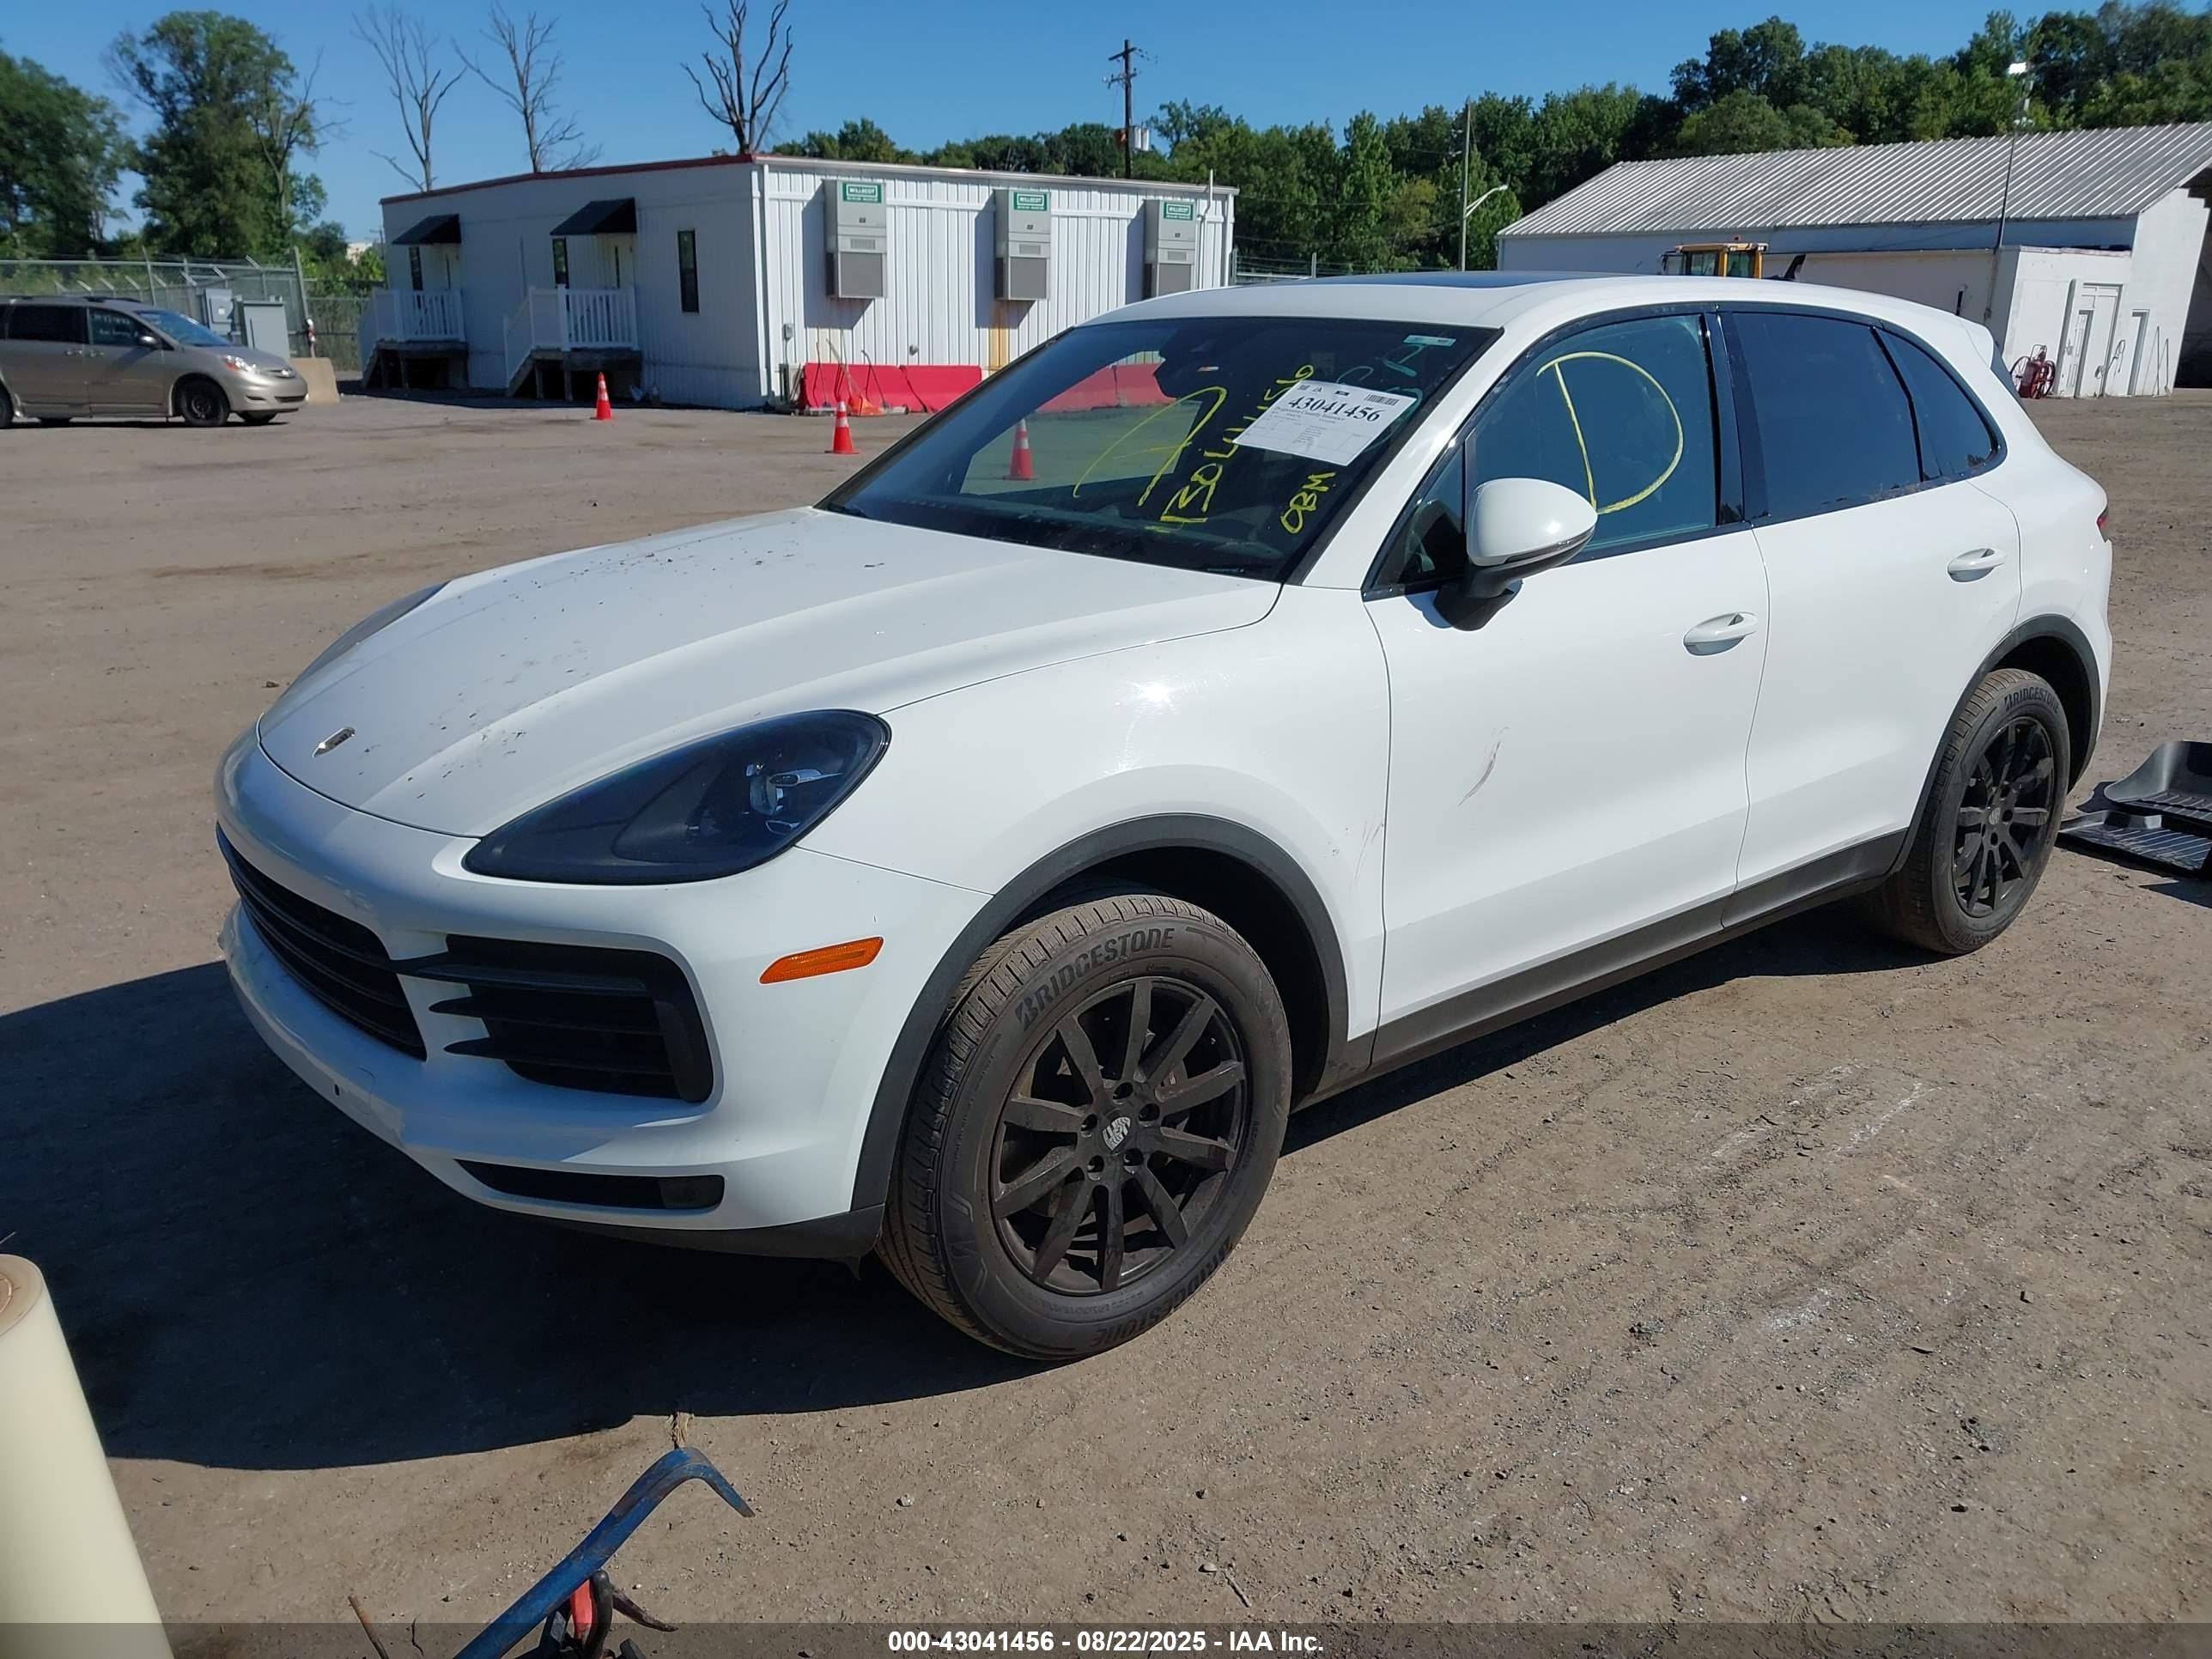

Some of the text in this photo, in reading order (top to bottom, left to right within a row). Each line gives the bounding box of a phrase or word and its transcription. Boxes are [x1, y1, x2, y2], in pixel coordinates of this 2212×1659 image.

[1287, 396, 1385, 422] 43041456
[2004, 686, 2060, 714] BRIDGESTONE
[1015, 927, 1176, 1031] BRIDGESTONE
